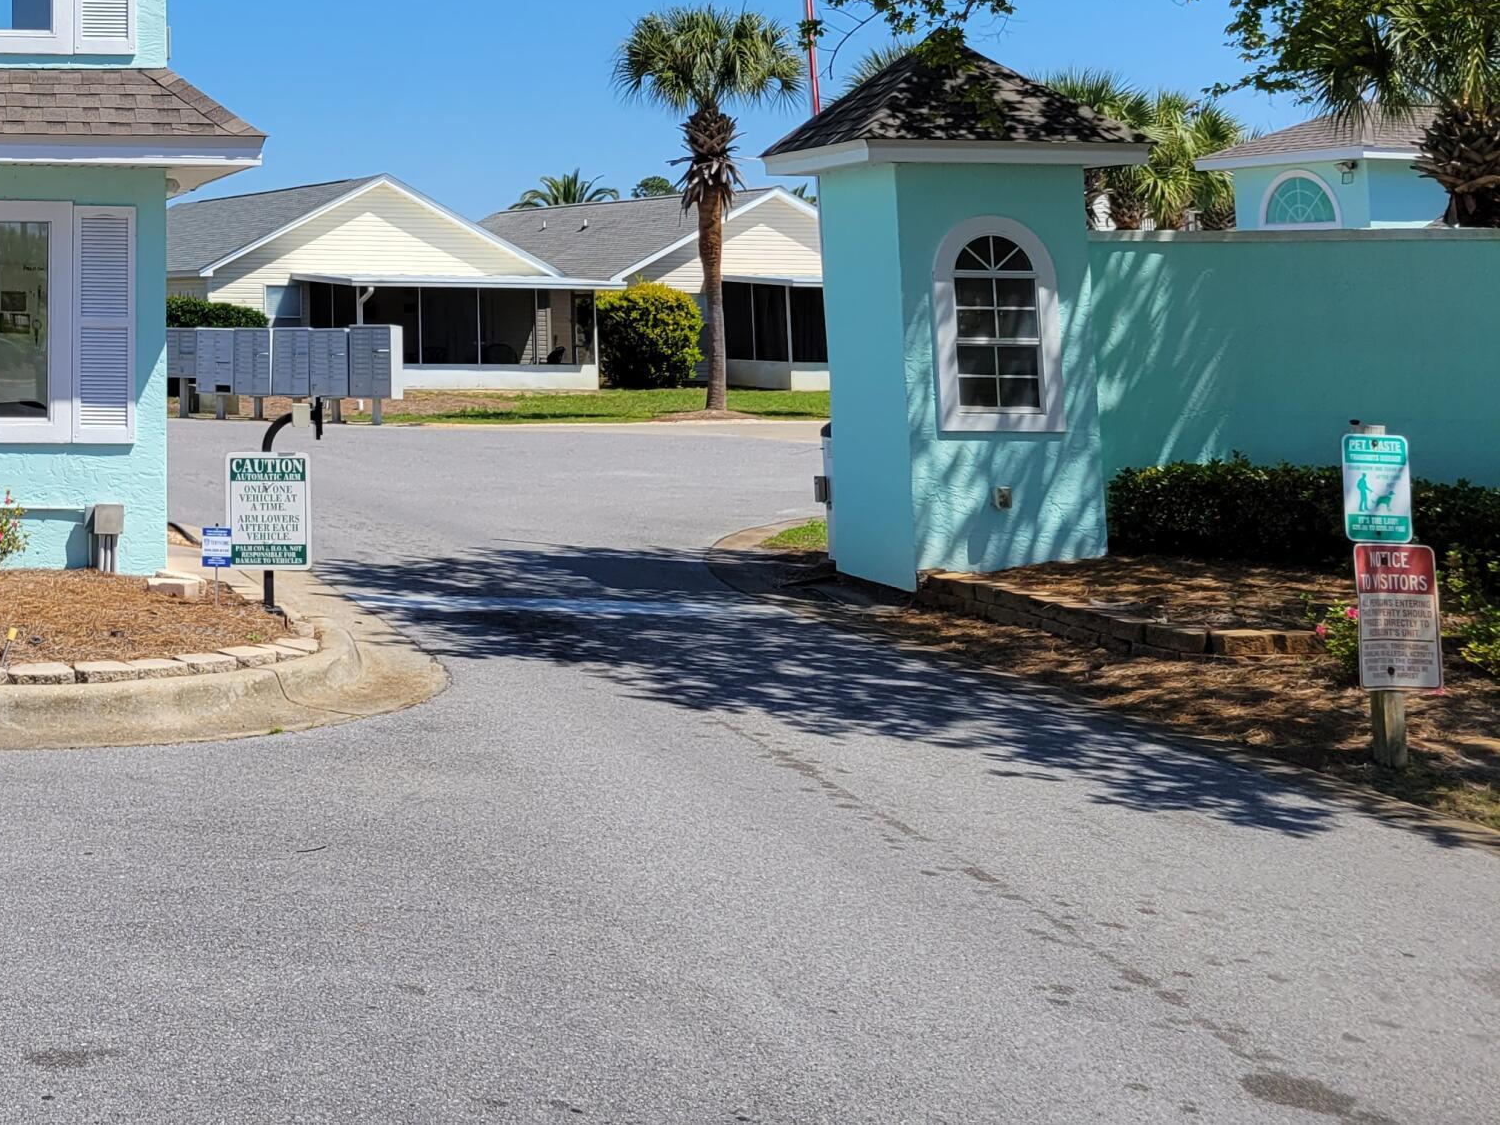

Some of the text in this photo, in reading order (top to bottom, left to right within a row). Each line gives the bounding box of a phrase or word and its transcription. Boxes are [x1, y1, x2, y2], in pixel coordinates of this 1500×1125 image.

[1348, 439, 1366, 450] PET
[232, 459, 303, 473] CAUTION
[244, 485, 292, 493] ONLY ONE
[239, 494, 297, 502] VEHICLE AT
[251, 503, 287, 511] A TIME.
[238, 515, 300, 523] ARM LOWERS
[238, 524, 298, 532] AFTER EACH
[247, 532, 292, 541] VEHICLE.
[1361, 573, 1428, 591] TO VISITORS
[1395, 600, 1431, 608] ENTERING
[1403, 609, 1432, 618] SHOULD
[1384, 618, 1418, 627] DIRECTLY
[1420, 620, 1429, 628] TO
